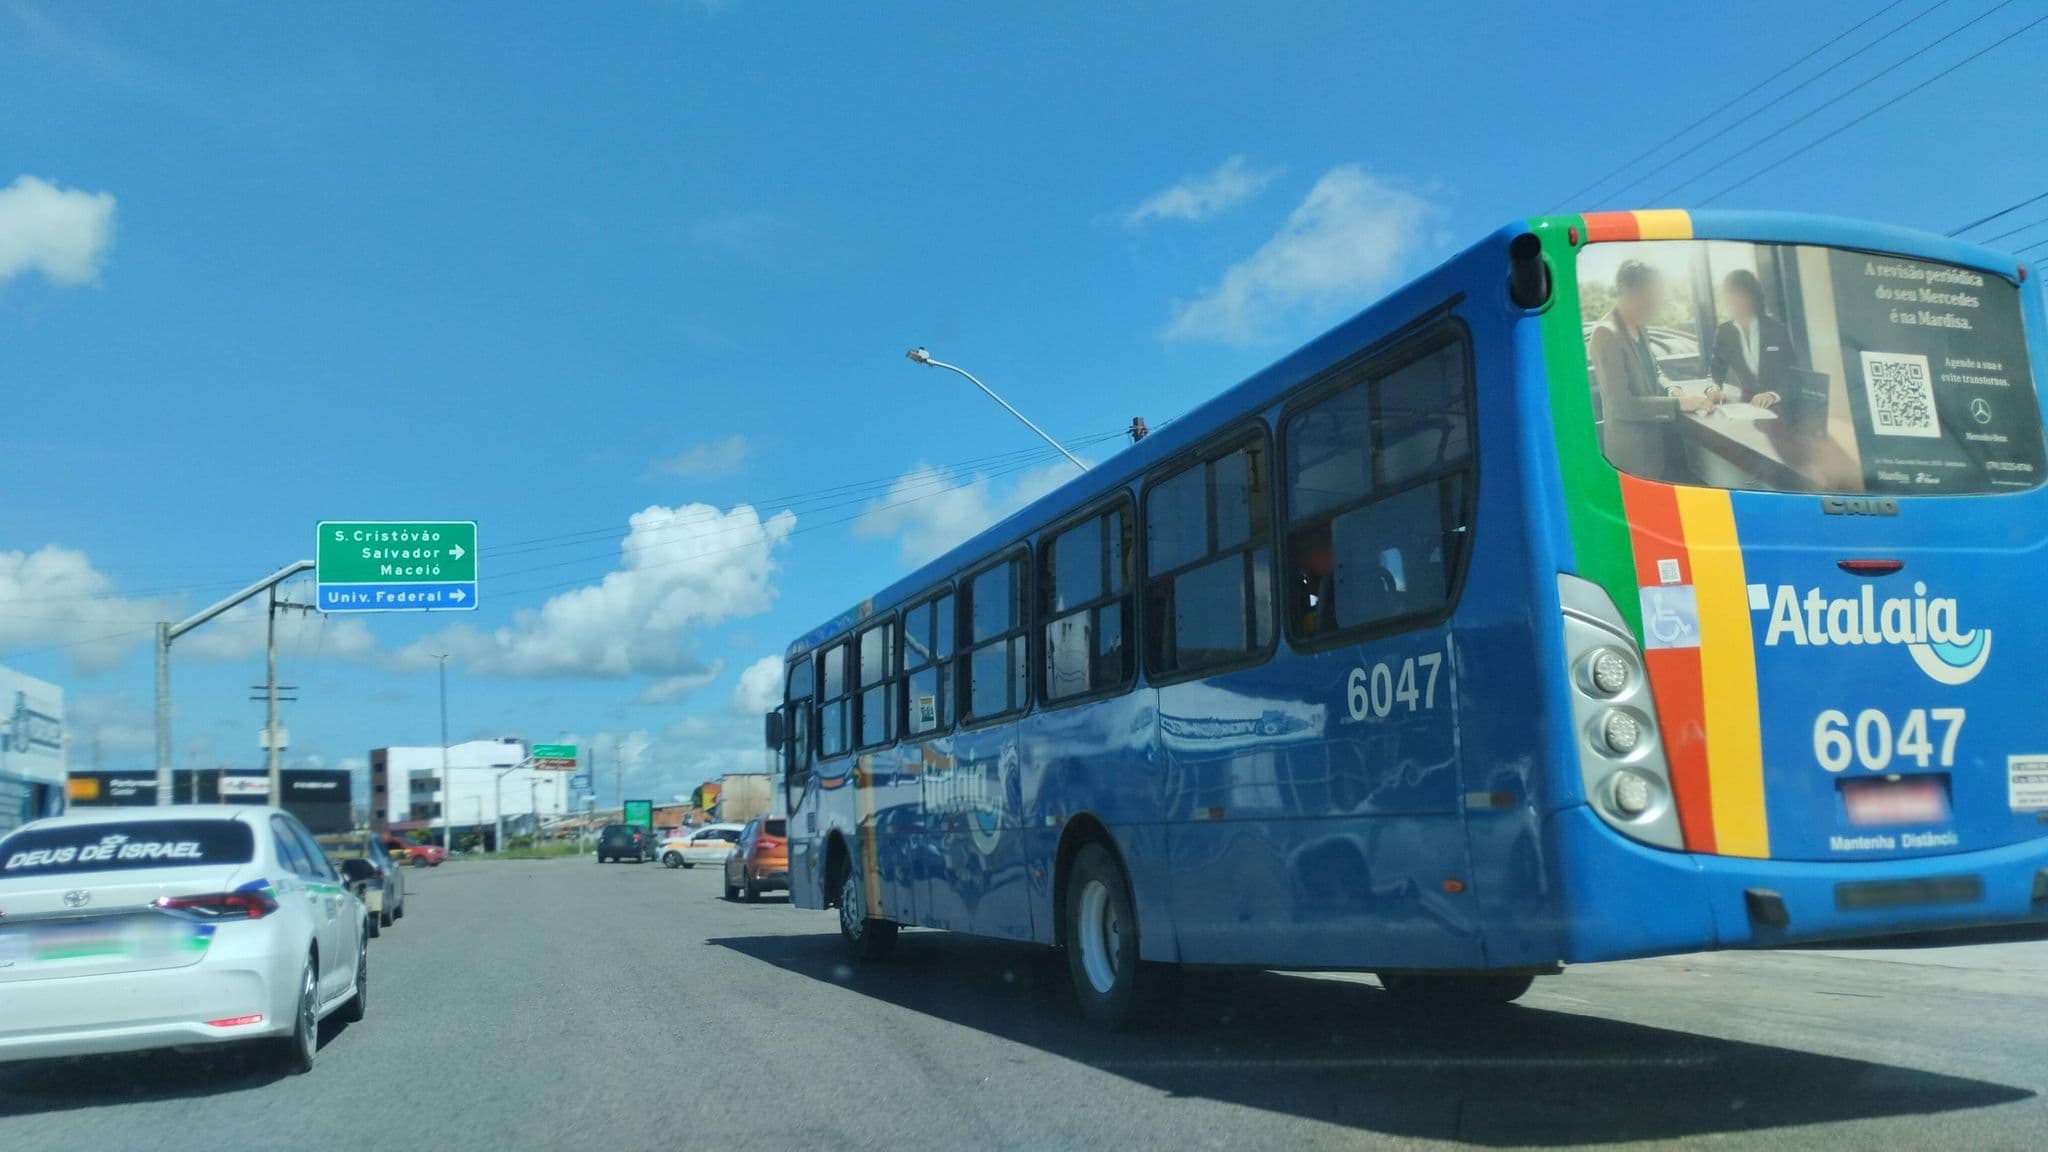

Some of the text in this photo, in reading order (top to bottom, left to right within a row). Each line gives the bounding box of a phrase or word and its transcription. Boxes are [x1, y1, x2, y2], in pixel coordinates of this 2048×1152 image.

[1864, 261, 1984, 287] A revisão periódica
[1875, 284, 1980, 308] do seu Mercedes
[1890, 307, 1899, 323] é
[1900, 313, 1917, 324] na
[1944, 357, 1975, 369] Agende
[1982, 361, 1996, 370] sua
[1941, 373, 1961, 383] evite
[335, 529, 440, 542] S. Cristóvão
[362, 547, 440, 559] Salvador
[380, 564, 441, 576] Maceió
[328, 590, 441, 603] Univ. Federal
[1764, 580, 1977, 647] Atalaia
[1346, 652, 1442, 721] 6047
[1813, 707, 1966, 772] 6047
[1829, 831, 1959, 850] Mantenha Distância
[5, 842, 203, 869] DEUS DE ISRAEL
